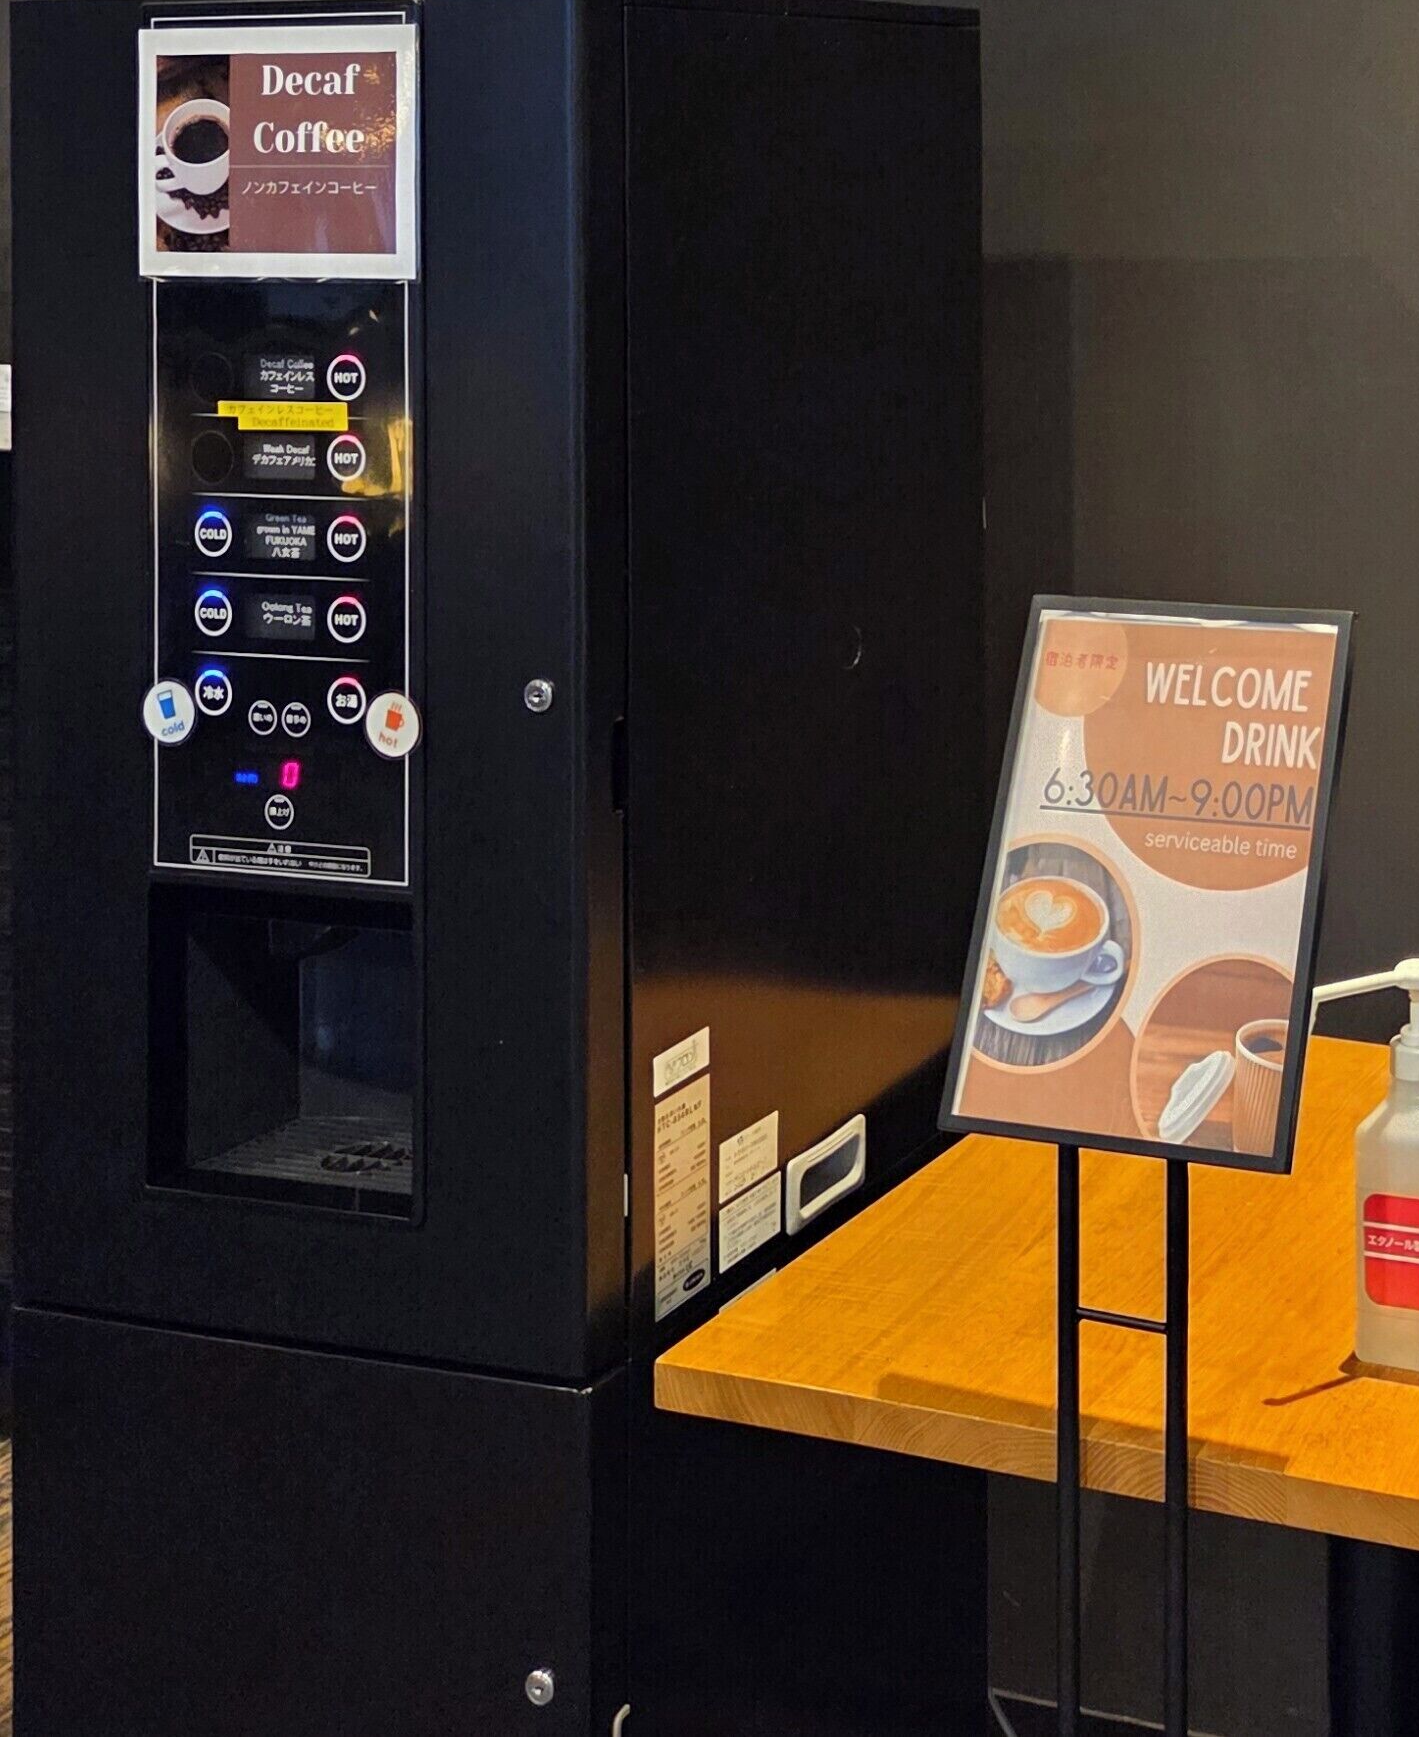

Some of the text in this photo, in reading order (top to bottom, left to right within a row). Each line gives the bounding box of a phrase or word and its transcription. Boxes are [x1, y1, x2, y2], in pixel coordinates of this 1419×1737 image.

[261, 63, 361, 95] Decaf
[253, 121, 365, 154] Coffee
[242, 181, 378, 195] ノンカフェインコーヒー
[260, 370, 315, 382] カフェインレス
[334, 372, 358, 384] HOT
[270, 383, 304, 394] コーヒー
[334, 452, 358, 464] HOT
[200, 527, 227, 541] COLD
[334, 533, 358, 545] HOT
[200, 607, 227, 620] COLD
[263, 612, 312, 627] ウーロン茶
[334, 614, 358, 627] HOT
[1145, 661, 1312, 713] WELCOME
[161, 720, 185, 737] cold
[378, 732, 399, 749] hot
[1221, 721, 1322, 770] DRINK
[1144, 831, 1298, 860] serviceable time
